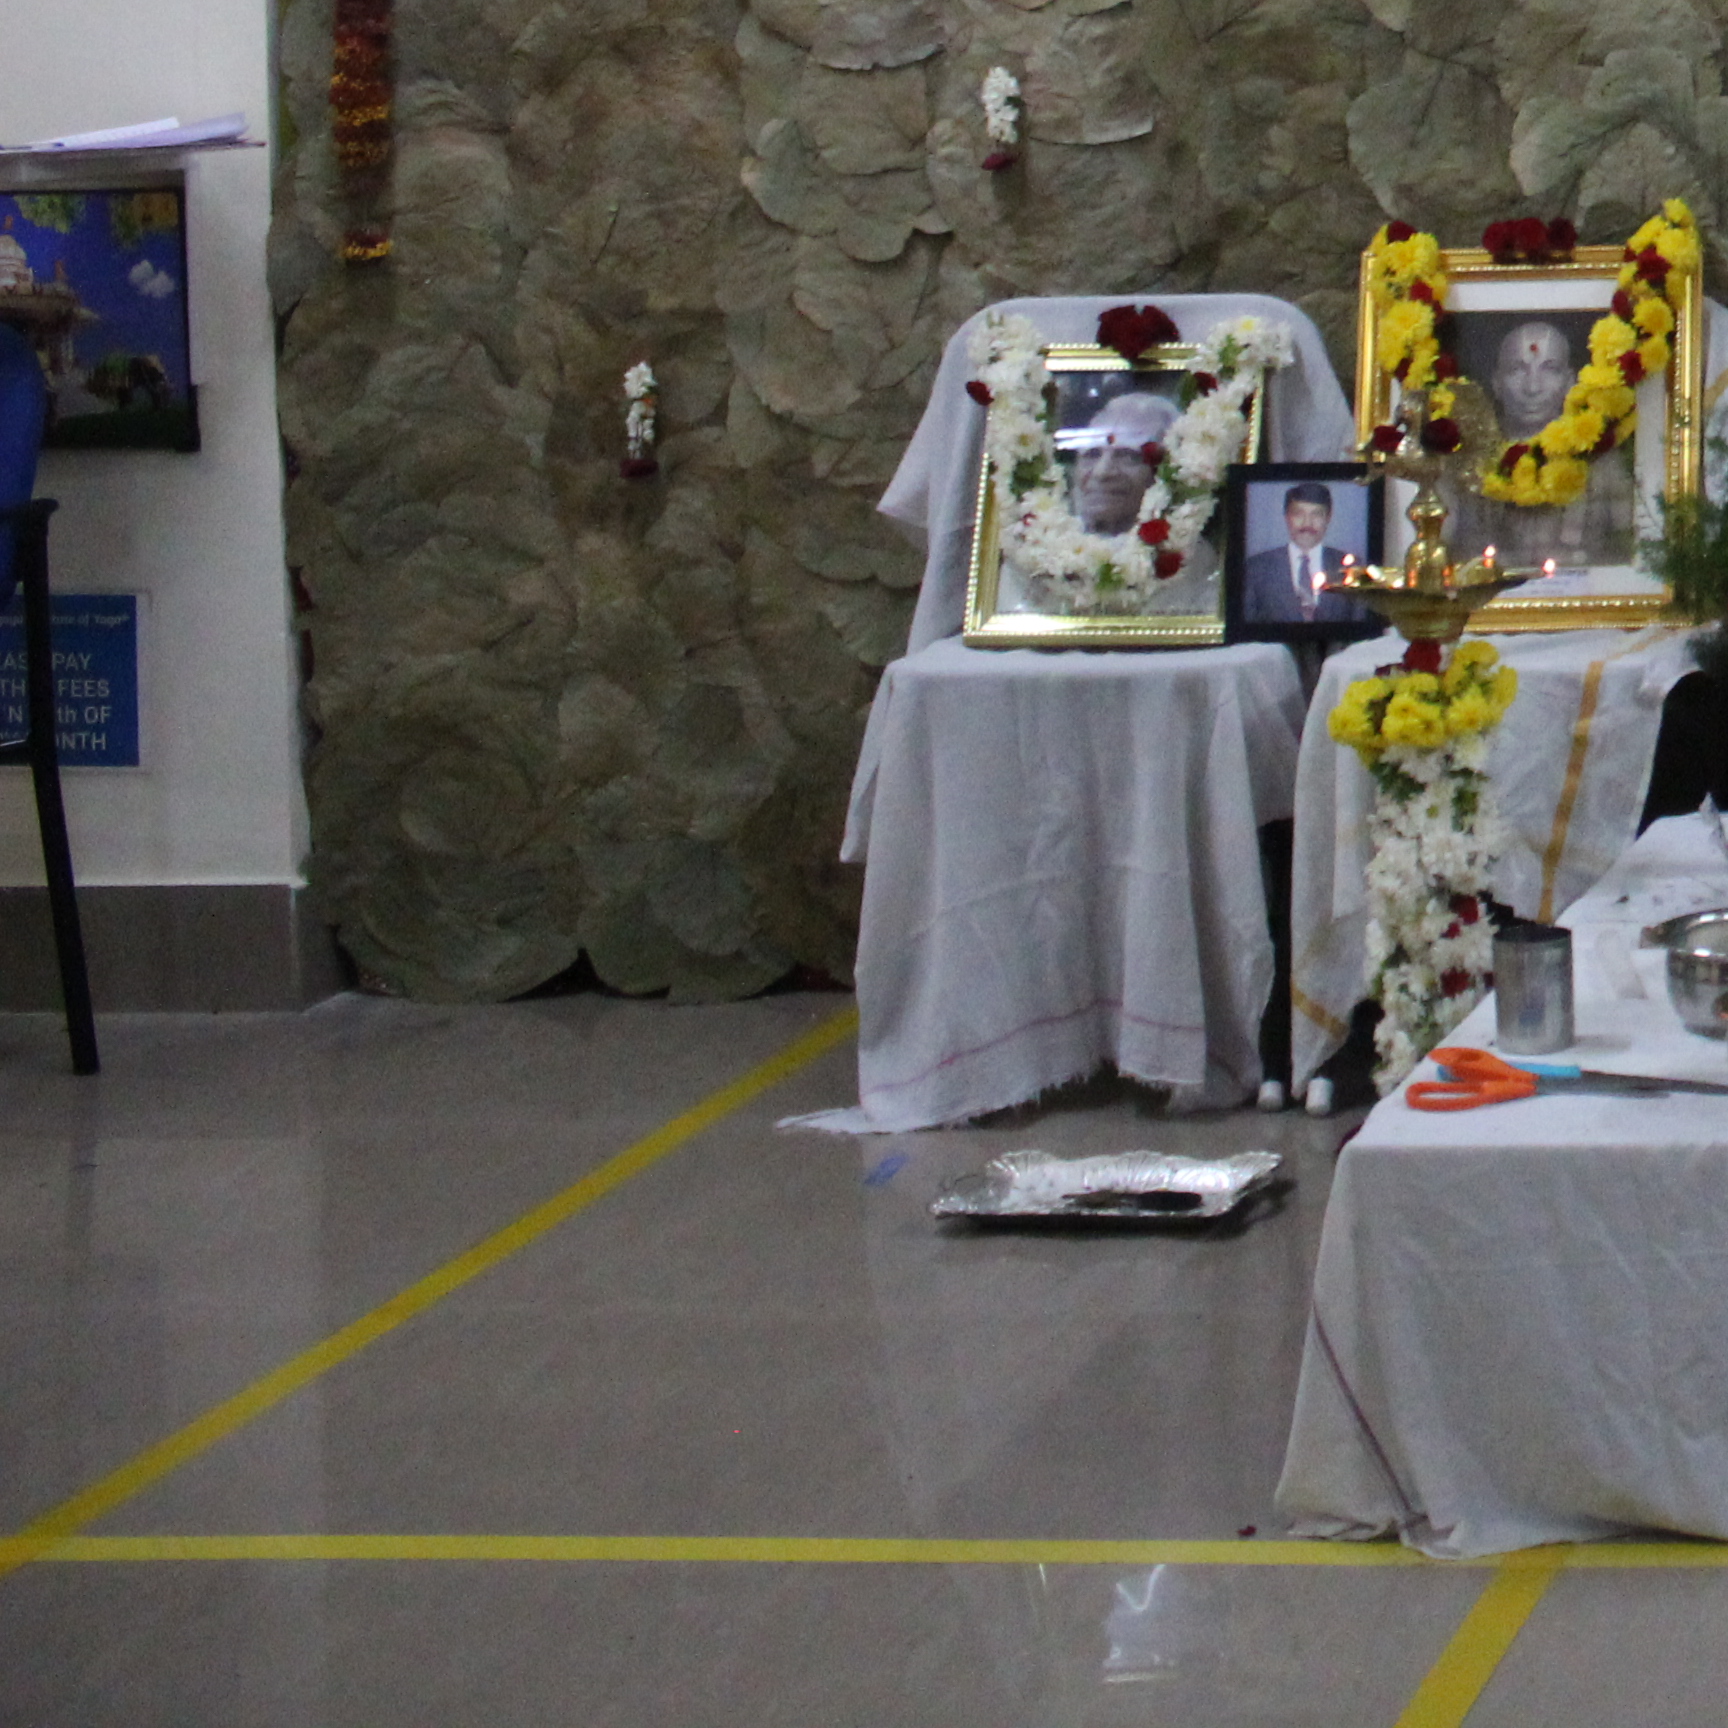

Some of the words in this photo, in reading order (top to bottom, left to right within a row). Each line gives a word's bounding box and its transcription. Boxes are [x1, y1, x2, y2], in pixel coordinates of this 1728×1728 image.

[51, 652, 92, 671] PAY
[57, 679, 110, 698] FEES
[84, 706, 112, 724] OF
